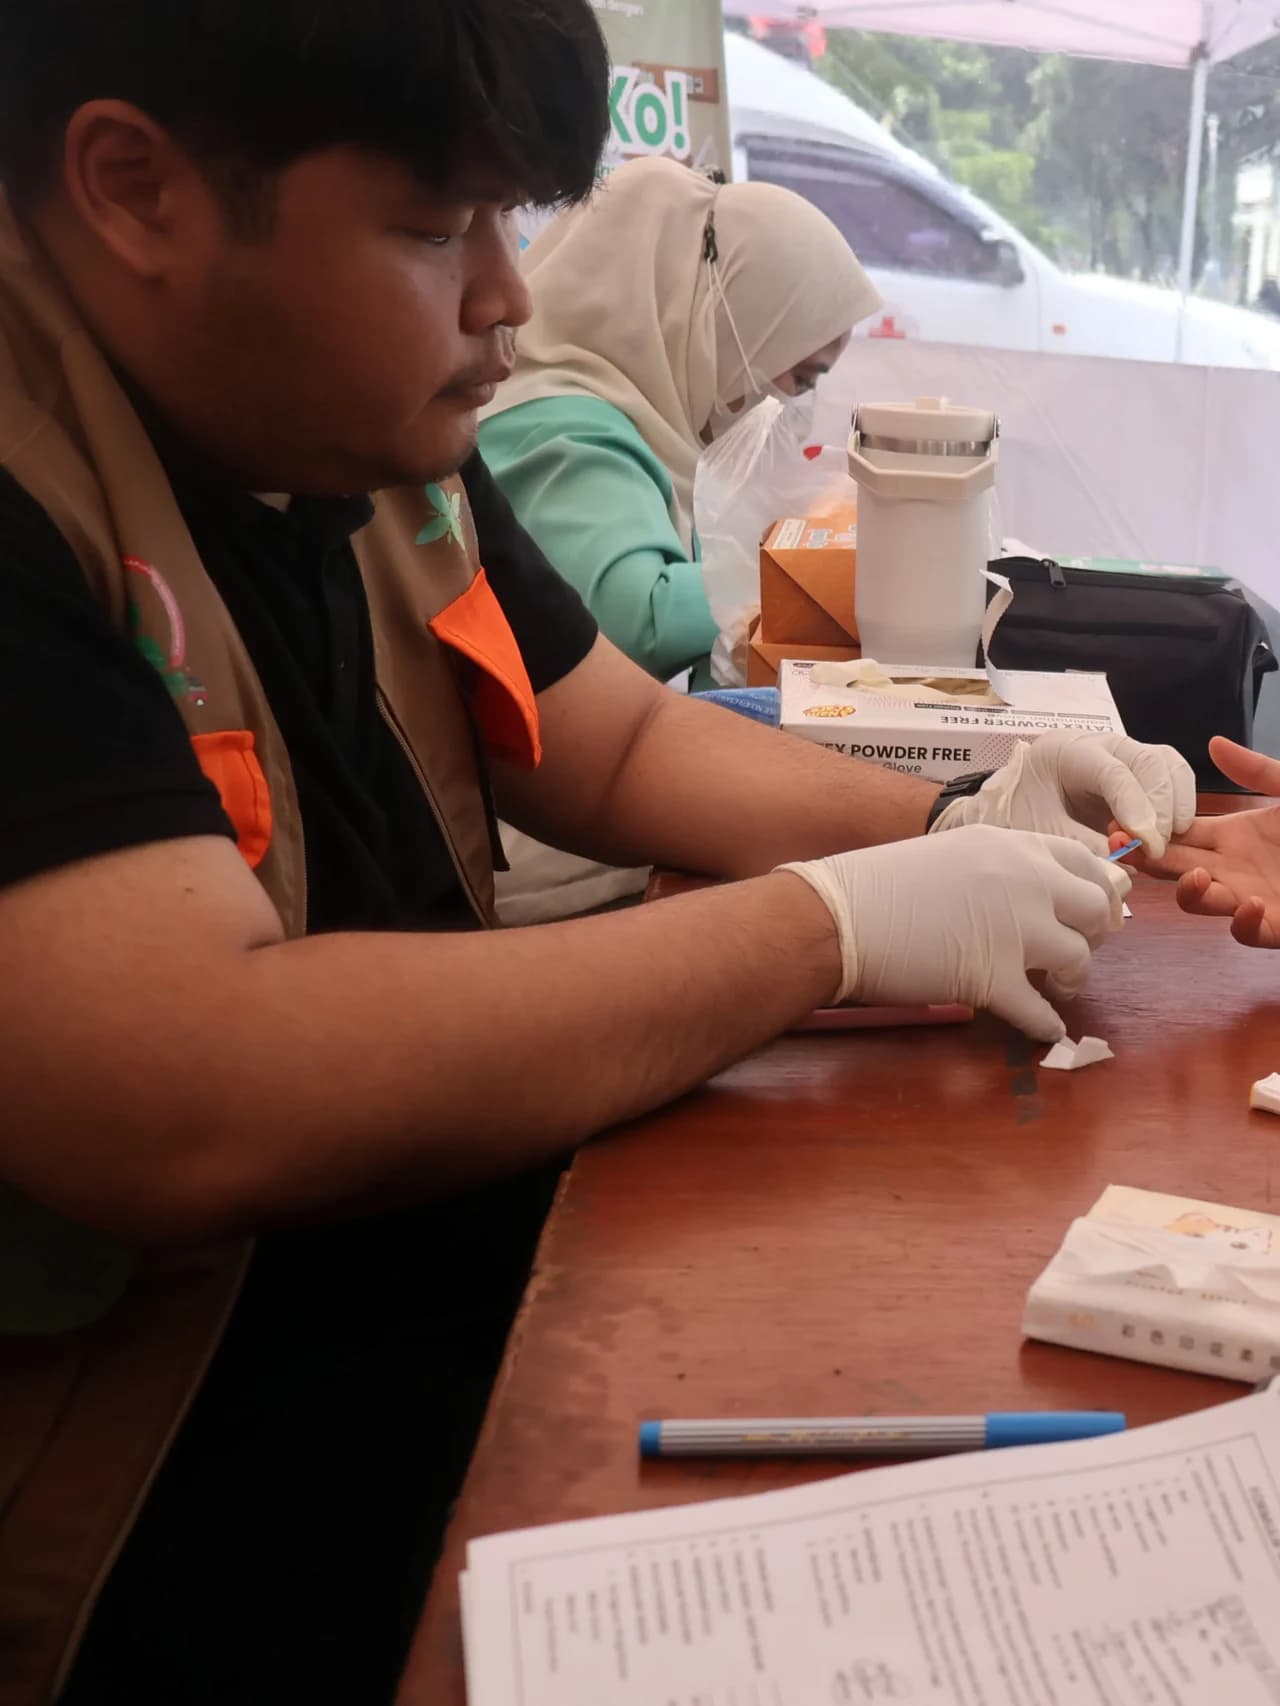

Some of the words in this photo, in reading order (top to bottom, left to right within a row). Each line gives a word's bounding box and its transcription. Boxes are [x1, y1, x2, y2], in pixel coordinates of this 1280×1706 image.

[940, 715, 979, 725] FREE
[984, 718, 1059, 729] POWDER
[850, 744, 928, 760] POWDER
[932, 747, 972, 761] FREE
[881, 761, 922, 774] Glove
